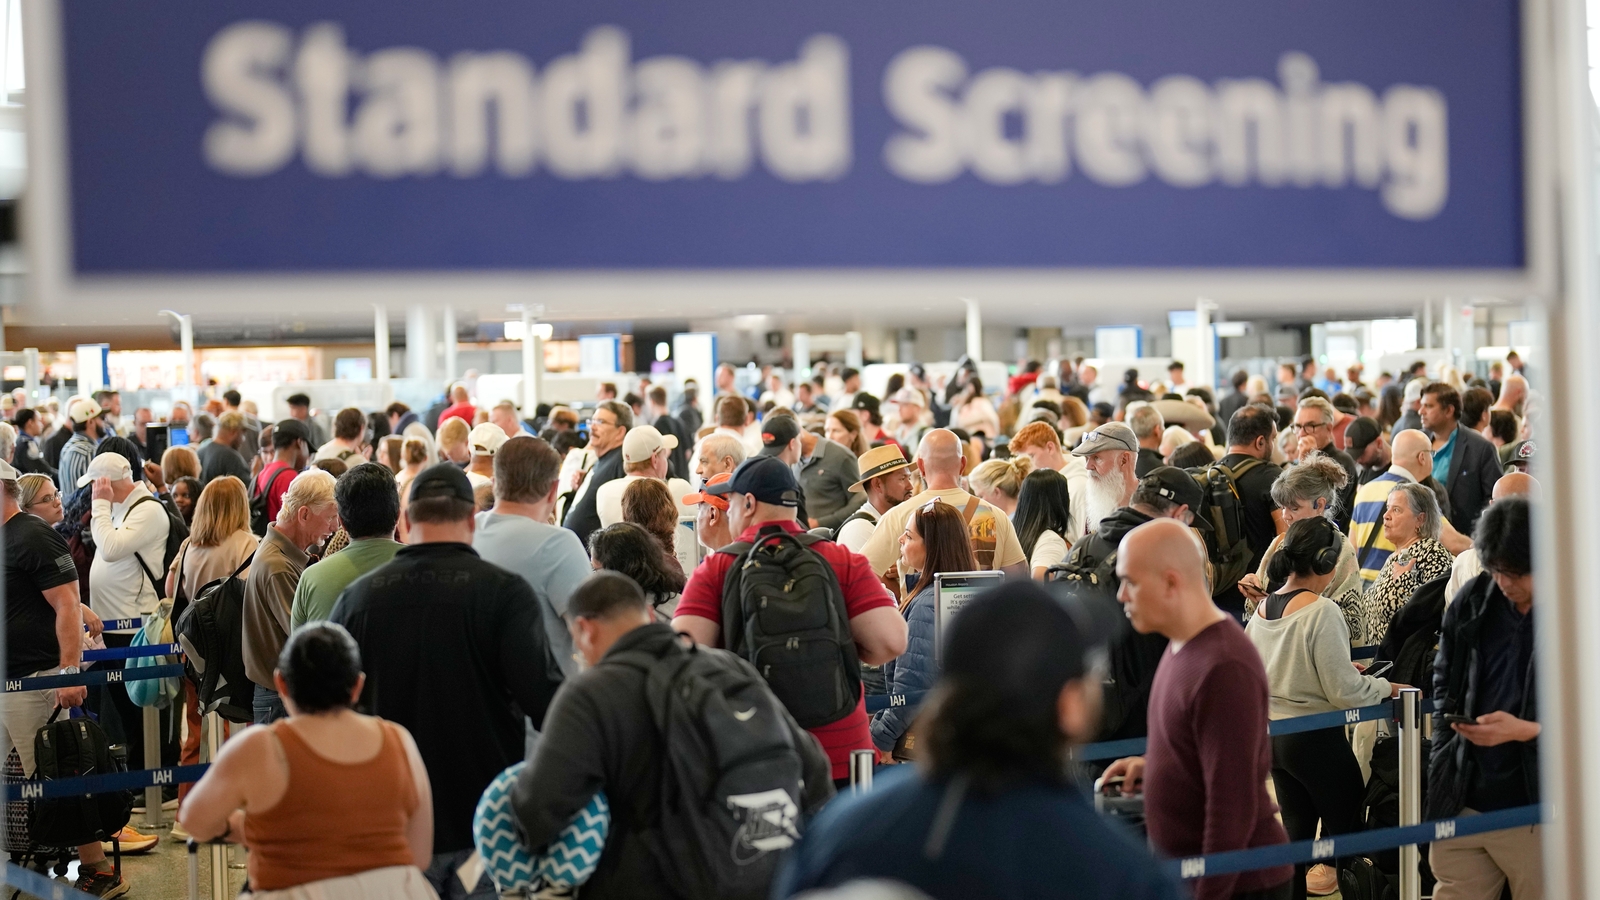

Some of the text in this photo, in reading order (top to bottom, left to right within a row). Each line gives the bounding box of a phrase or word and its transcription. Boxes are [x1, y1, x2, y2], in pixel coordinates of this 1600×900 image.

[202, 21, 1448, 220] Standard Screening
[117, 619, 132, 629] IAH
[1242, 612, 1251, 622] IA
[107, 671, 122, 682] IAH
[6, 680, 22, 691] IAH
[890, 694, 906, 706] IAH
[1345, 709, 1360, 722] IAH
[152, 769, 173, 784] IAH
[21, 783, 43, 798] IAH
[1435, 820, 1456, 839] IAH
[1311, 838, 1335, 859] IAH
[1180, 857, 1206, 879] IAH
